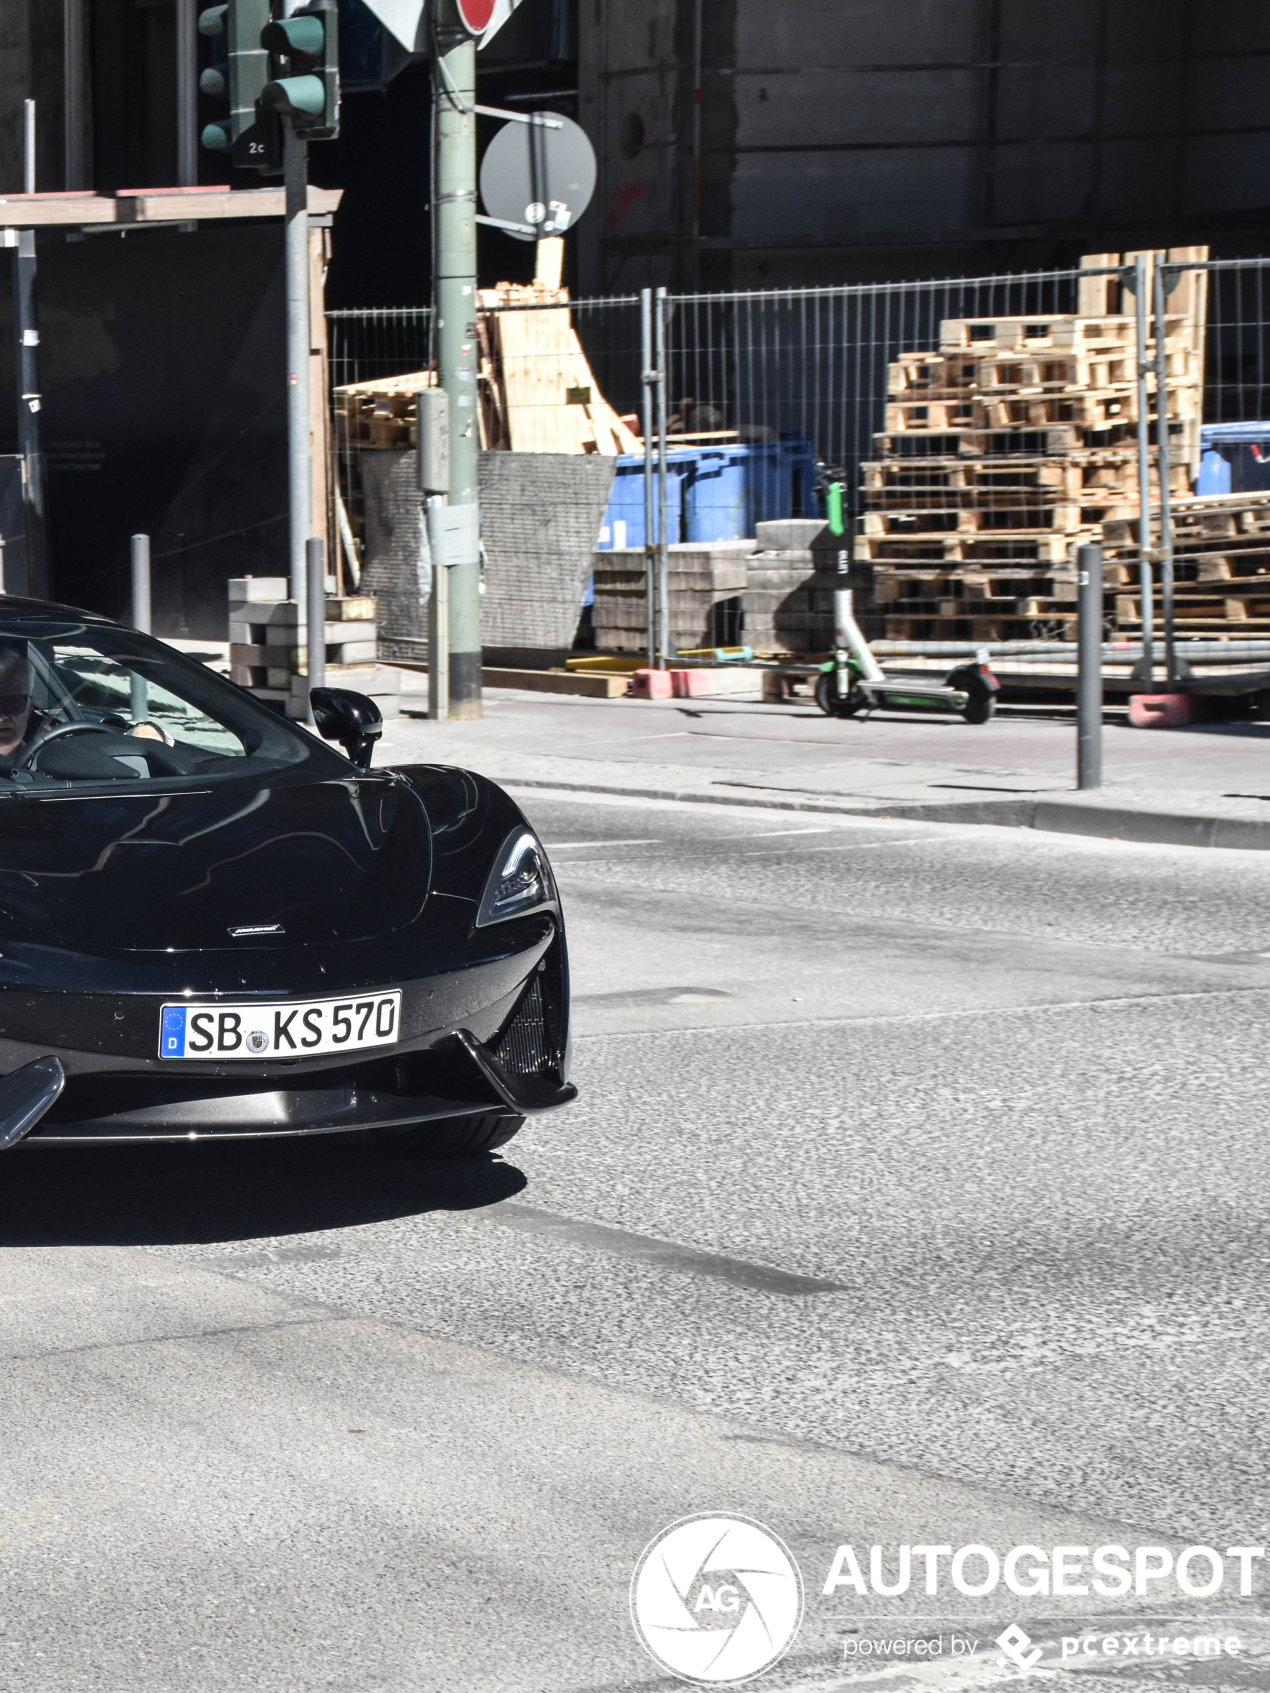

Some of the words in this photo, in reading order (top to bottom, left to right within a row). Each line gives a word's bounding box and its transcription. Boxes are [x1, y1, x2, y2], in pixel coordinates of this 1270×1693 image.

[188, 1012, 243, 1052] SB
[273, 1008, 323, 1050] KS
[332, 998, 395, 1044] 570
[168, 1037, 178, 1050] D
